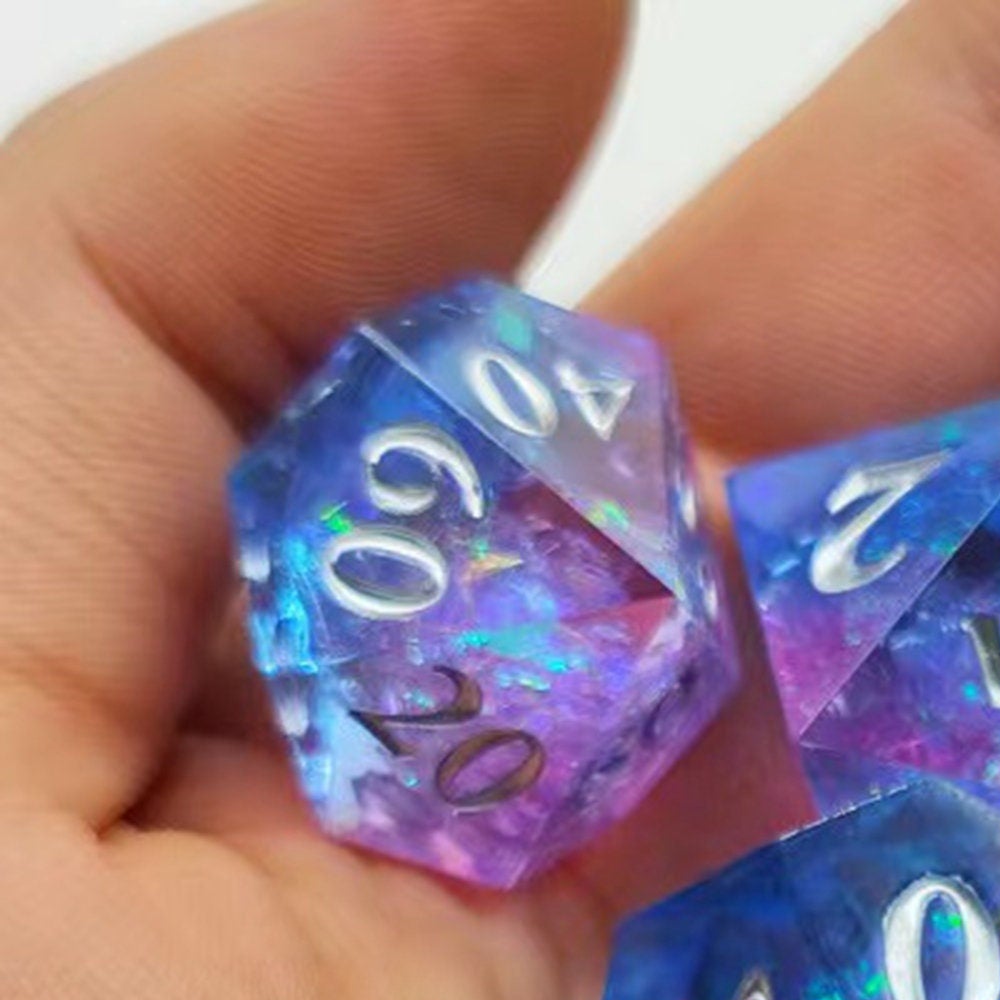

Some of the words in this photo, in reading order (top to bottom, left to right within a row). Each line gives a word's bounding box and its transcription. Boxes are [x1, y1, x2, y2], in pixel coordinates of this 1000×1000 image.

[463, 346, 638, 443] 40
[322, 422, 487, 622] 60
[810, 445, 955, 595] 2
[350, 665, 547, 812] 20
